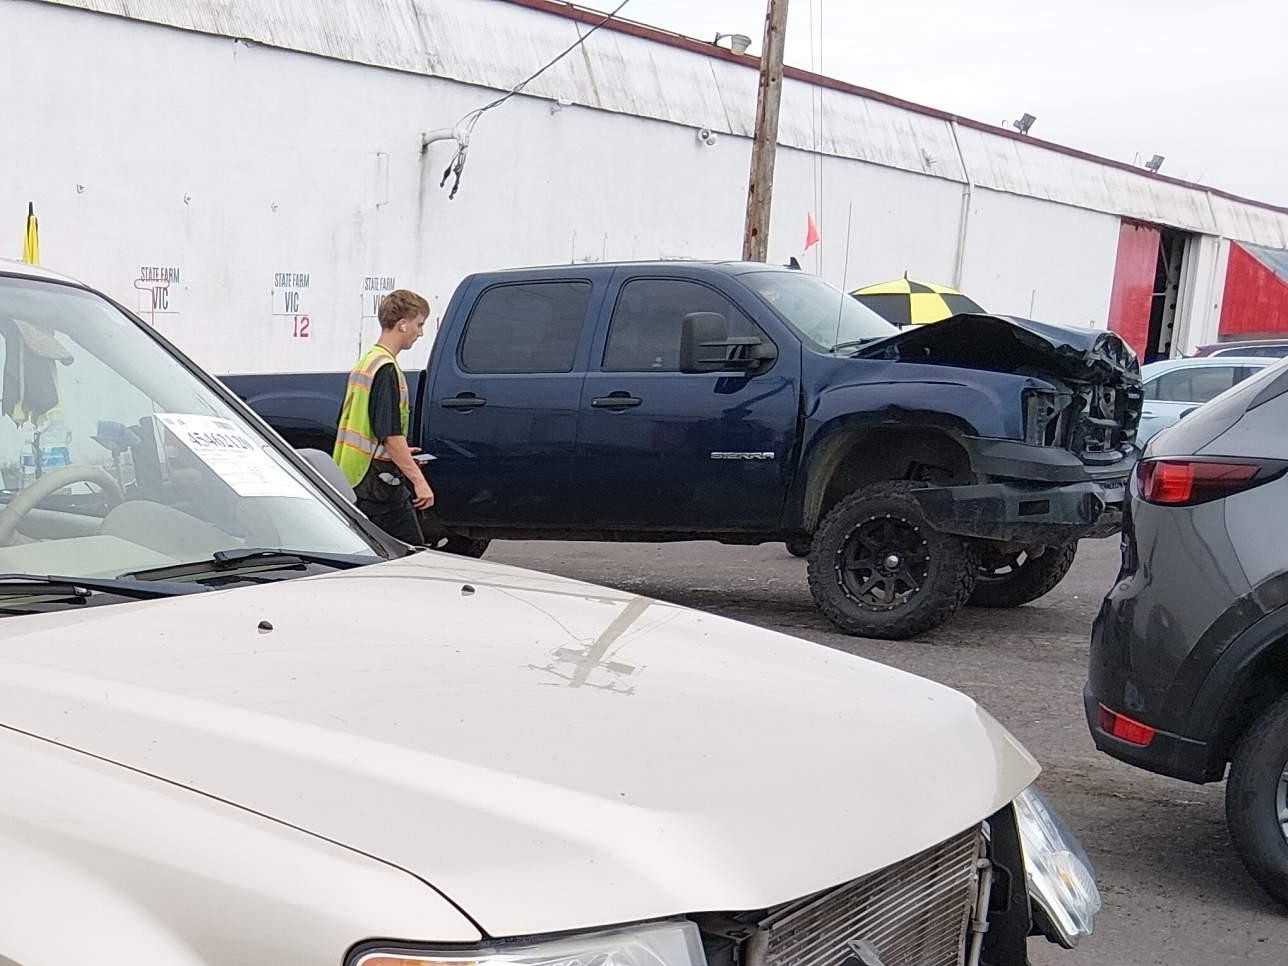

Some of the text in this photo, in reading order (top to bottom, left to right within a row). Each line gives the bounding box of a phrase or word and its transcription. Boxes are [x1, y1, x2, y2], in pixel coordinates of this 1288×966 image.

[141, 266, 180, 283] STATE FARM
[274, 272, 310, 288] STATE FARM
[364, 277, 379, 291] STATE
[152, 286, 169, 310] VIC
[284, 291, 299, 313] VIC
[373, 294, 386, 315] VI
[293, 316, 310, 337] 12
[710, 451, 775, 460] SIERRA
